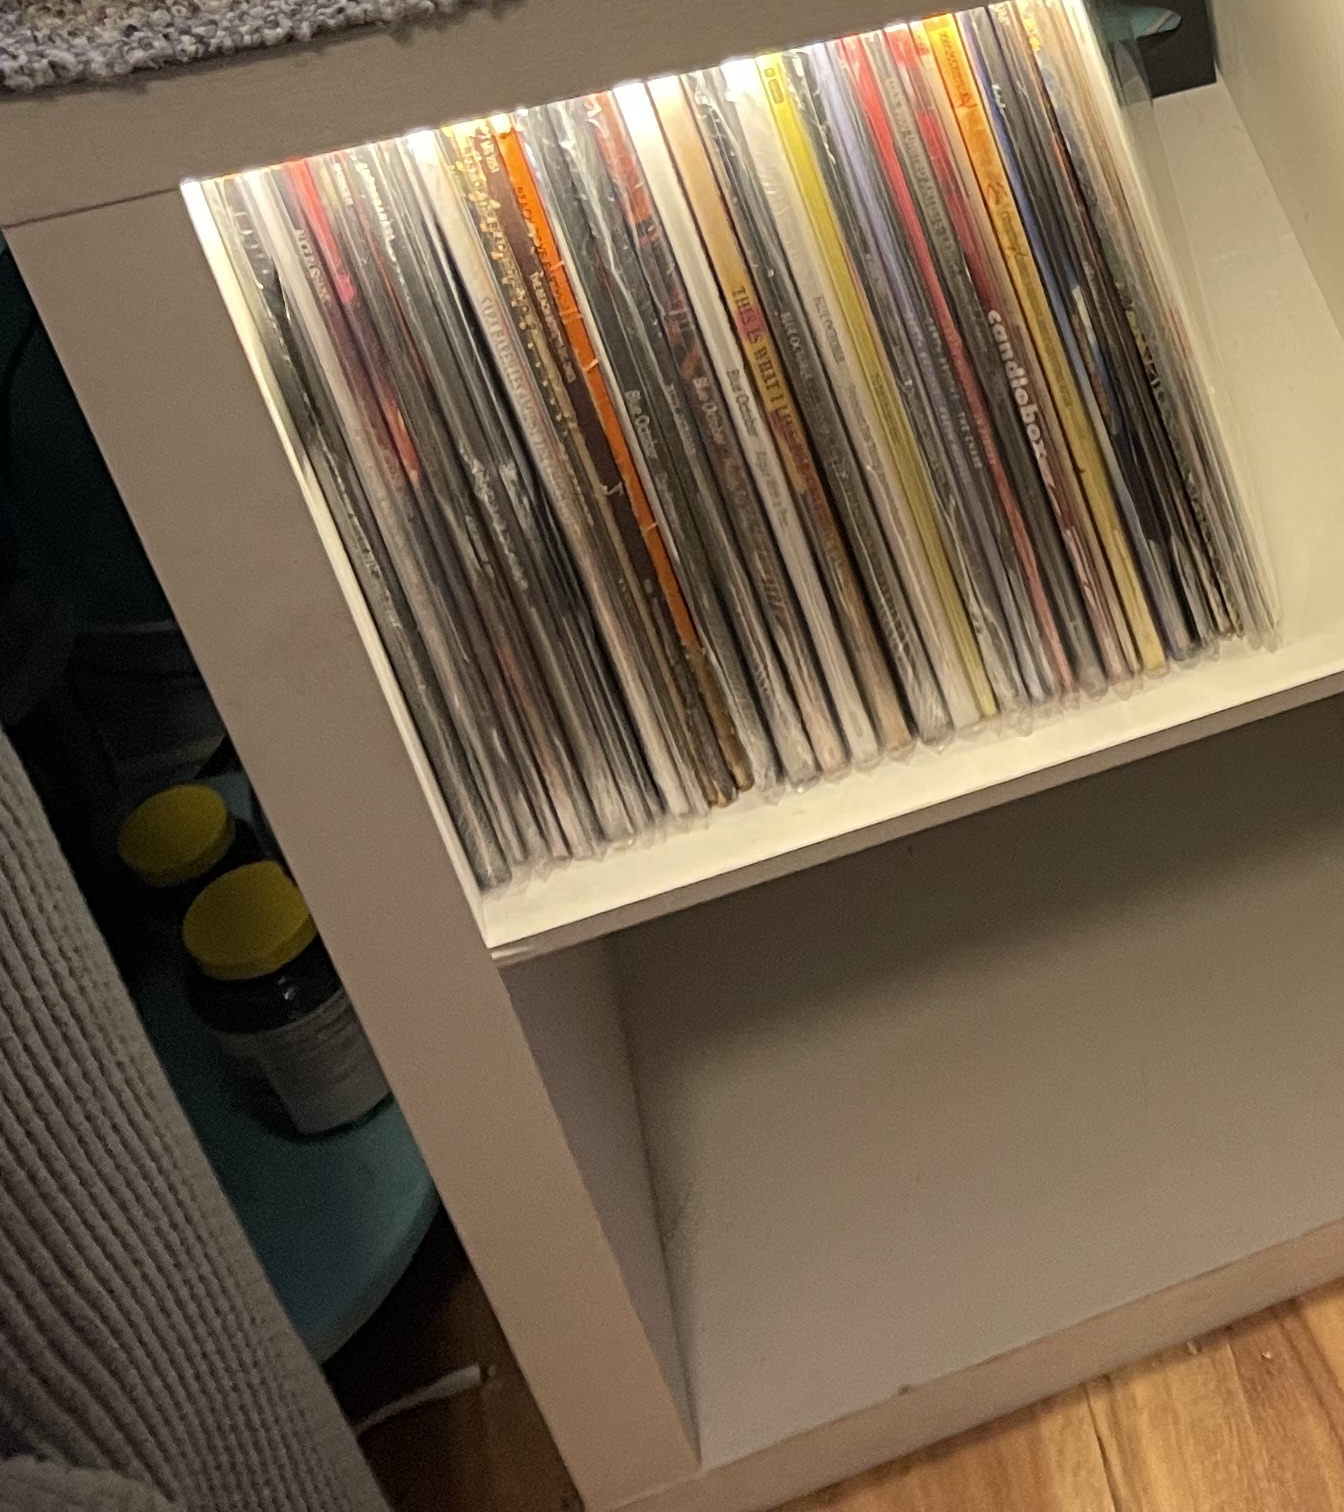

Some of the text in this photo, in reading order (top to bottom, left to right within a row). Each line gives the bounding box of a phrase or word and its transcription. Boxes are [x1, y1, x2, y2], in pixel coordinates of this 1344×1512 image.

[730, 286, 757, 325] THIS
[744, 327, 764, 345] IS
[725, 368, 746, 393] Blue
[751, 346, 781, 392] WHAT
[987, 308, 1049, 462] candlebox
[623, 388, 662, 460] Blue October
[690, 376, 729, 446] Blue October
[734, 393, 762, 439] October
